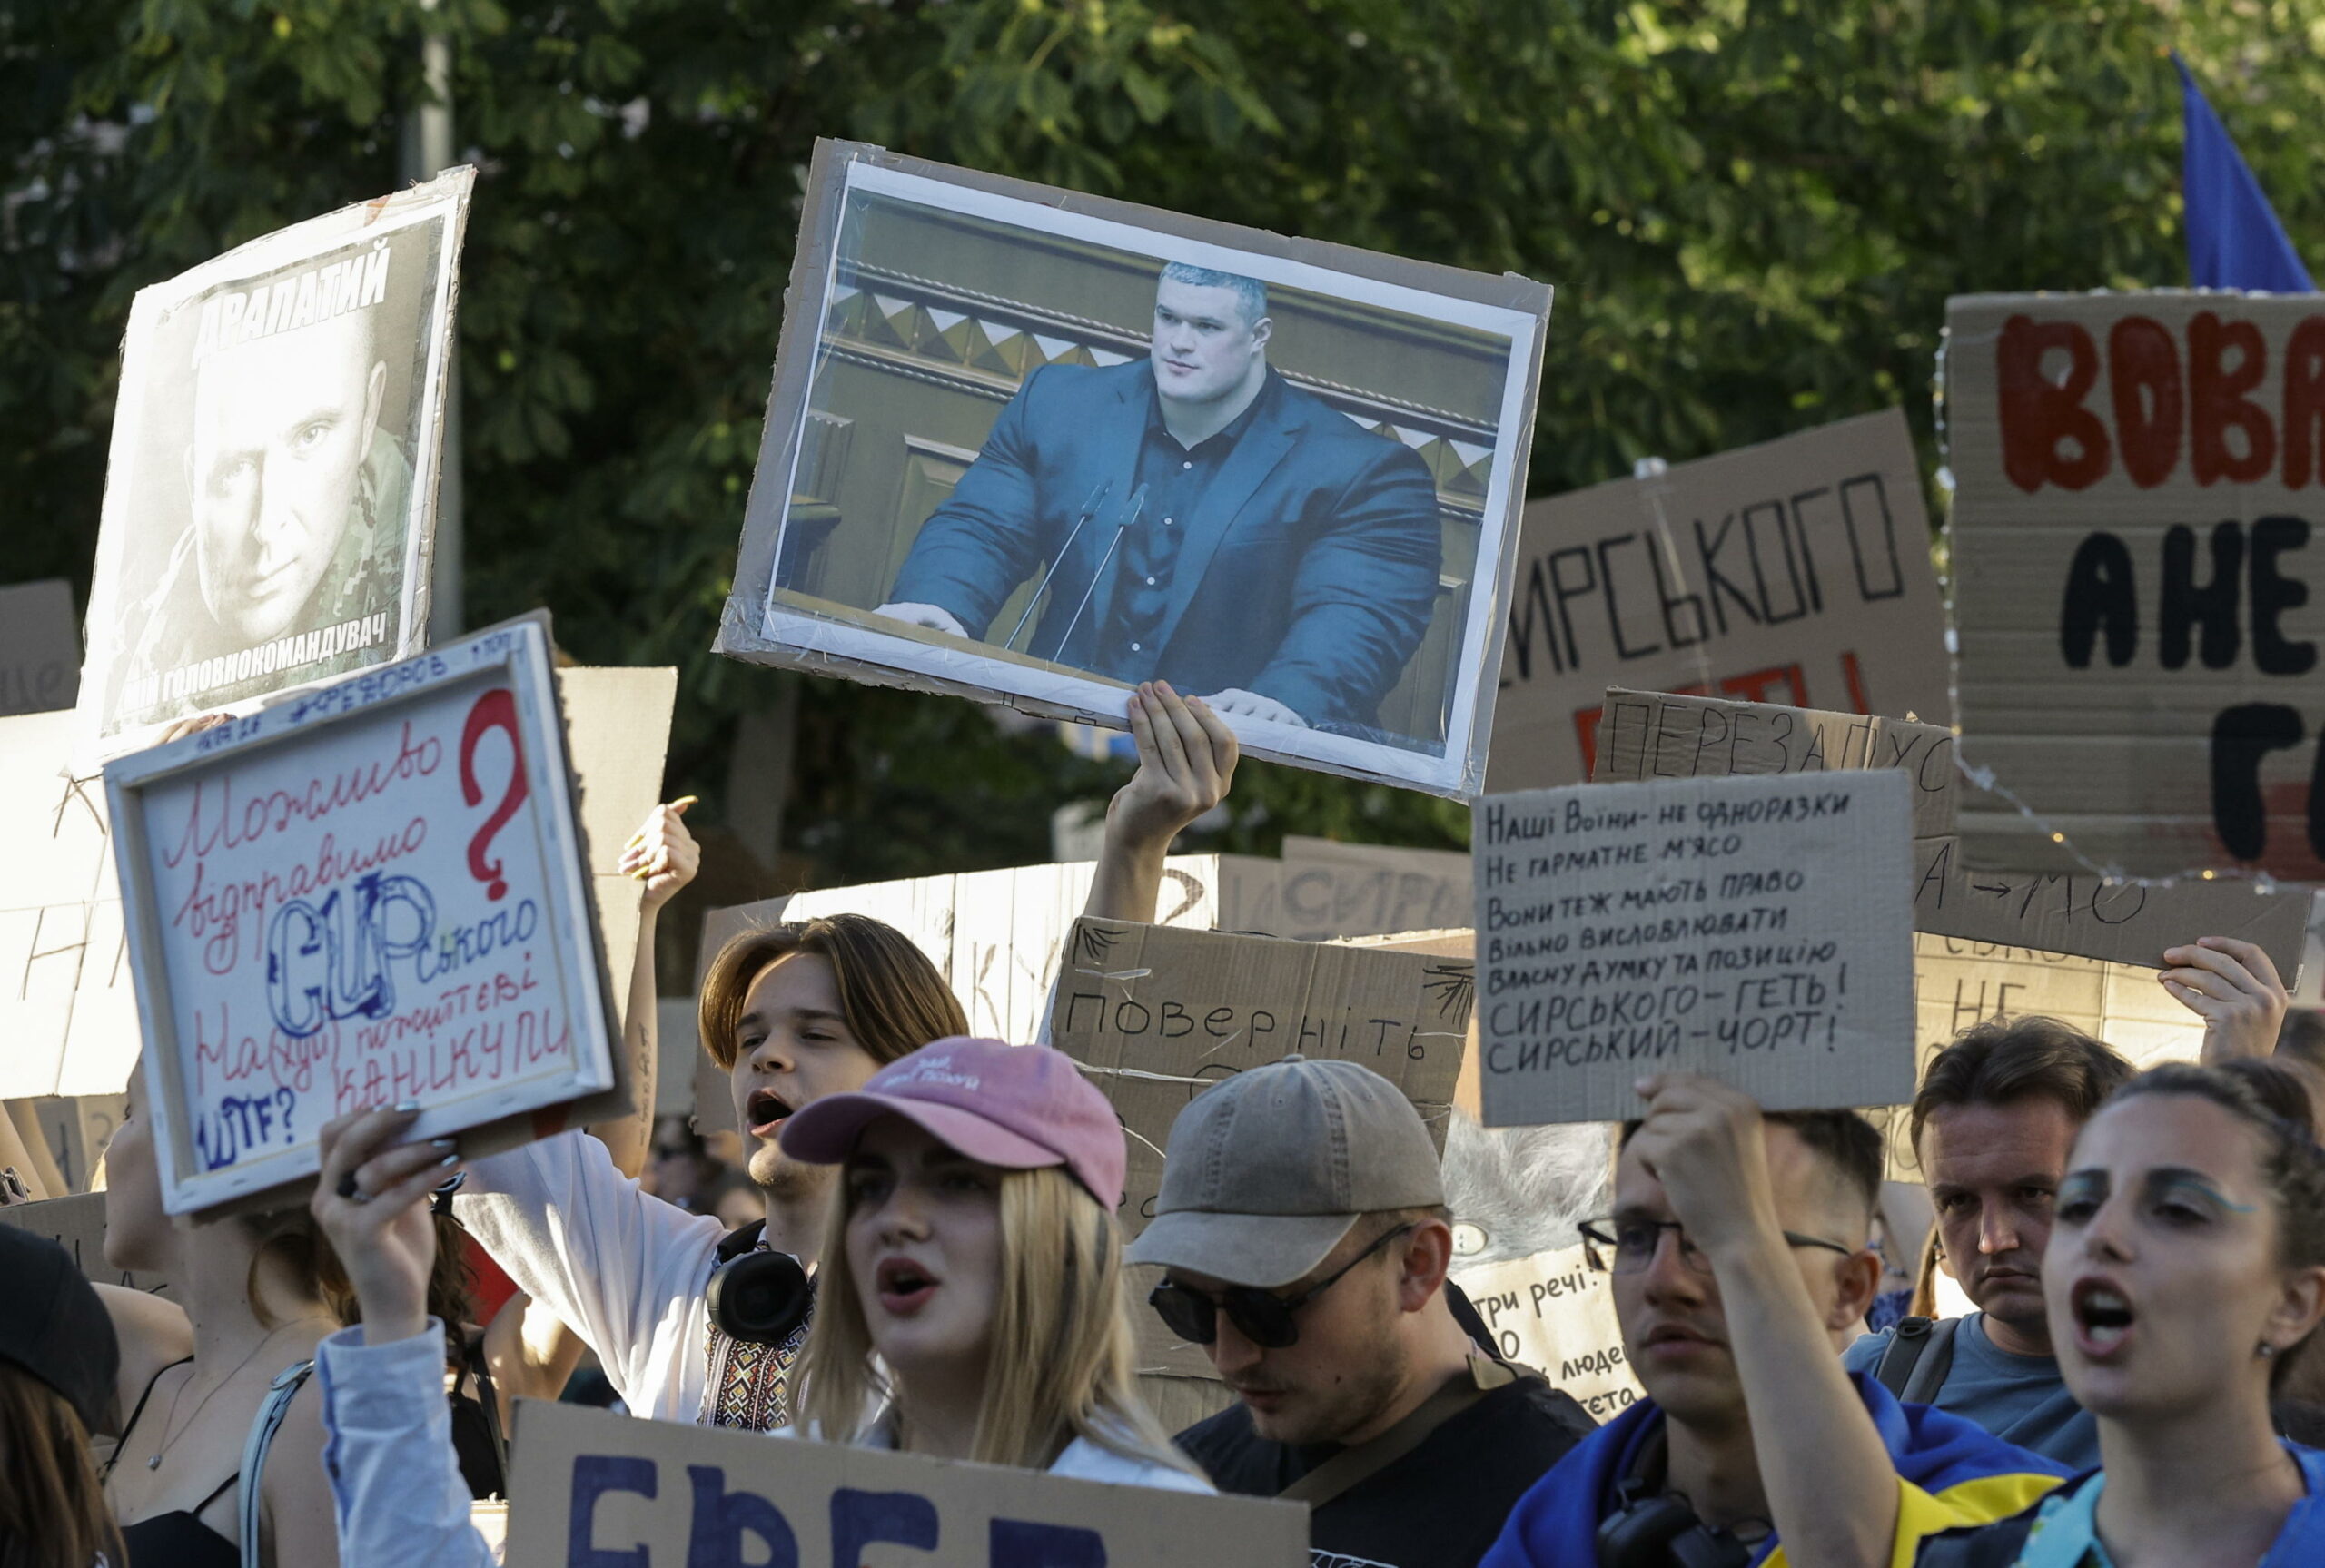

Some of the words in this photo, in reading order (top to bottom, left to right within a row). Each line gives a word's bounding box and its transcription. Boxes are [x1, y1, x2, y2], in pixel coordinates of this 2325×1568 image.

[192, 240, 391, 369] ДРАПАТИЙ
[1498, 472, 1905, 688] ИРСЬКОГО
[163, 613, 388, 703] ГОЛОВНОКОМАНДУВАЧ
[1610, 703, 1953, 792] ПЕРЕЗАПУС
